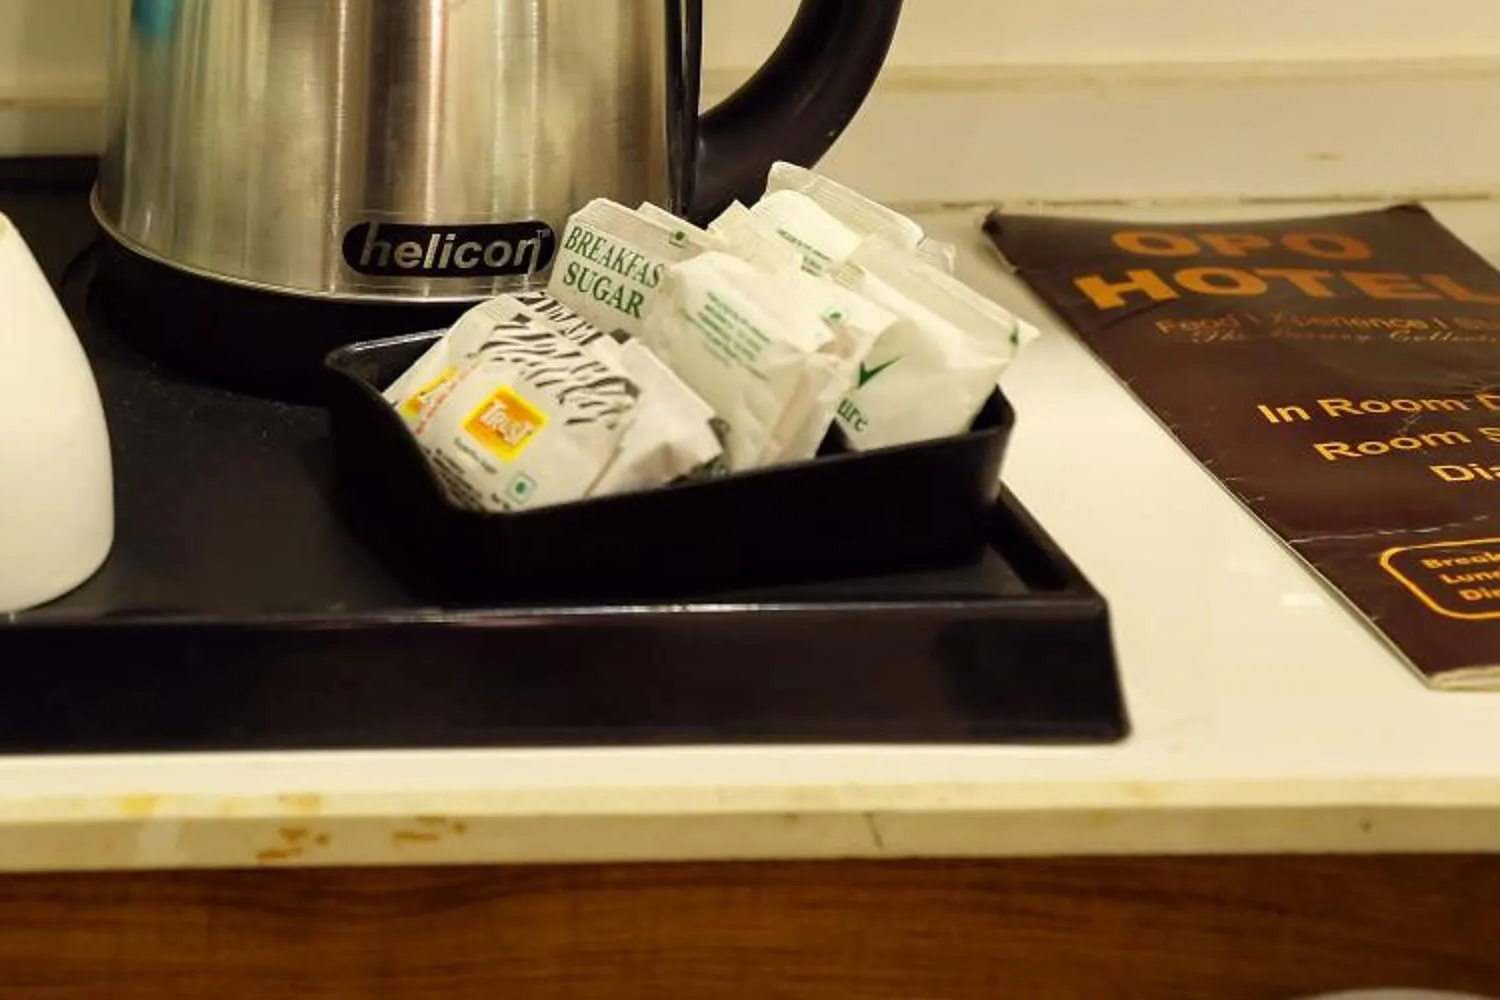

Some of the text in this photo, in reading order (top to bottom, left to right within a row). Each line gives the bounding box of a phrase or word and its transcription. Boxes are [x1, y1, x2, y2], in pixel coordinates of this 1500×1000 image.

[359, 220, 542, 278] helicon
[564, 225, 665, 289] BREAKFAS
[1111, 230, 1373, 260] OPO
[563, 261, 645, 320] SUGAR
[836, 398, 868, 433] ure
[1257, 404, 1312, 424] In
[1316, 398, 1471, 417] Room
[1313, 431, 1472, 461] Room
